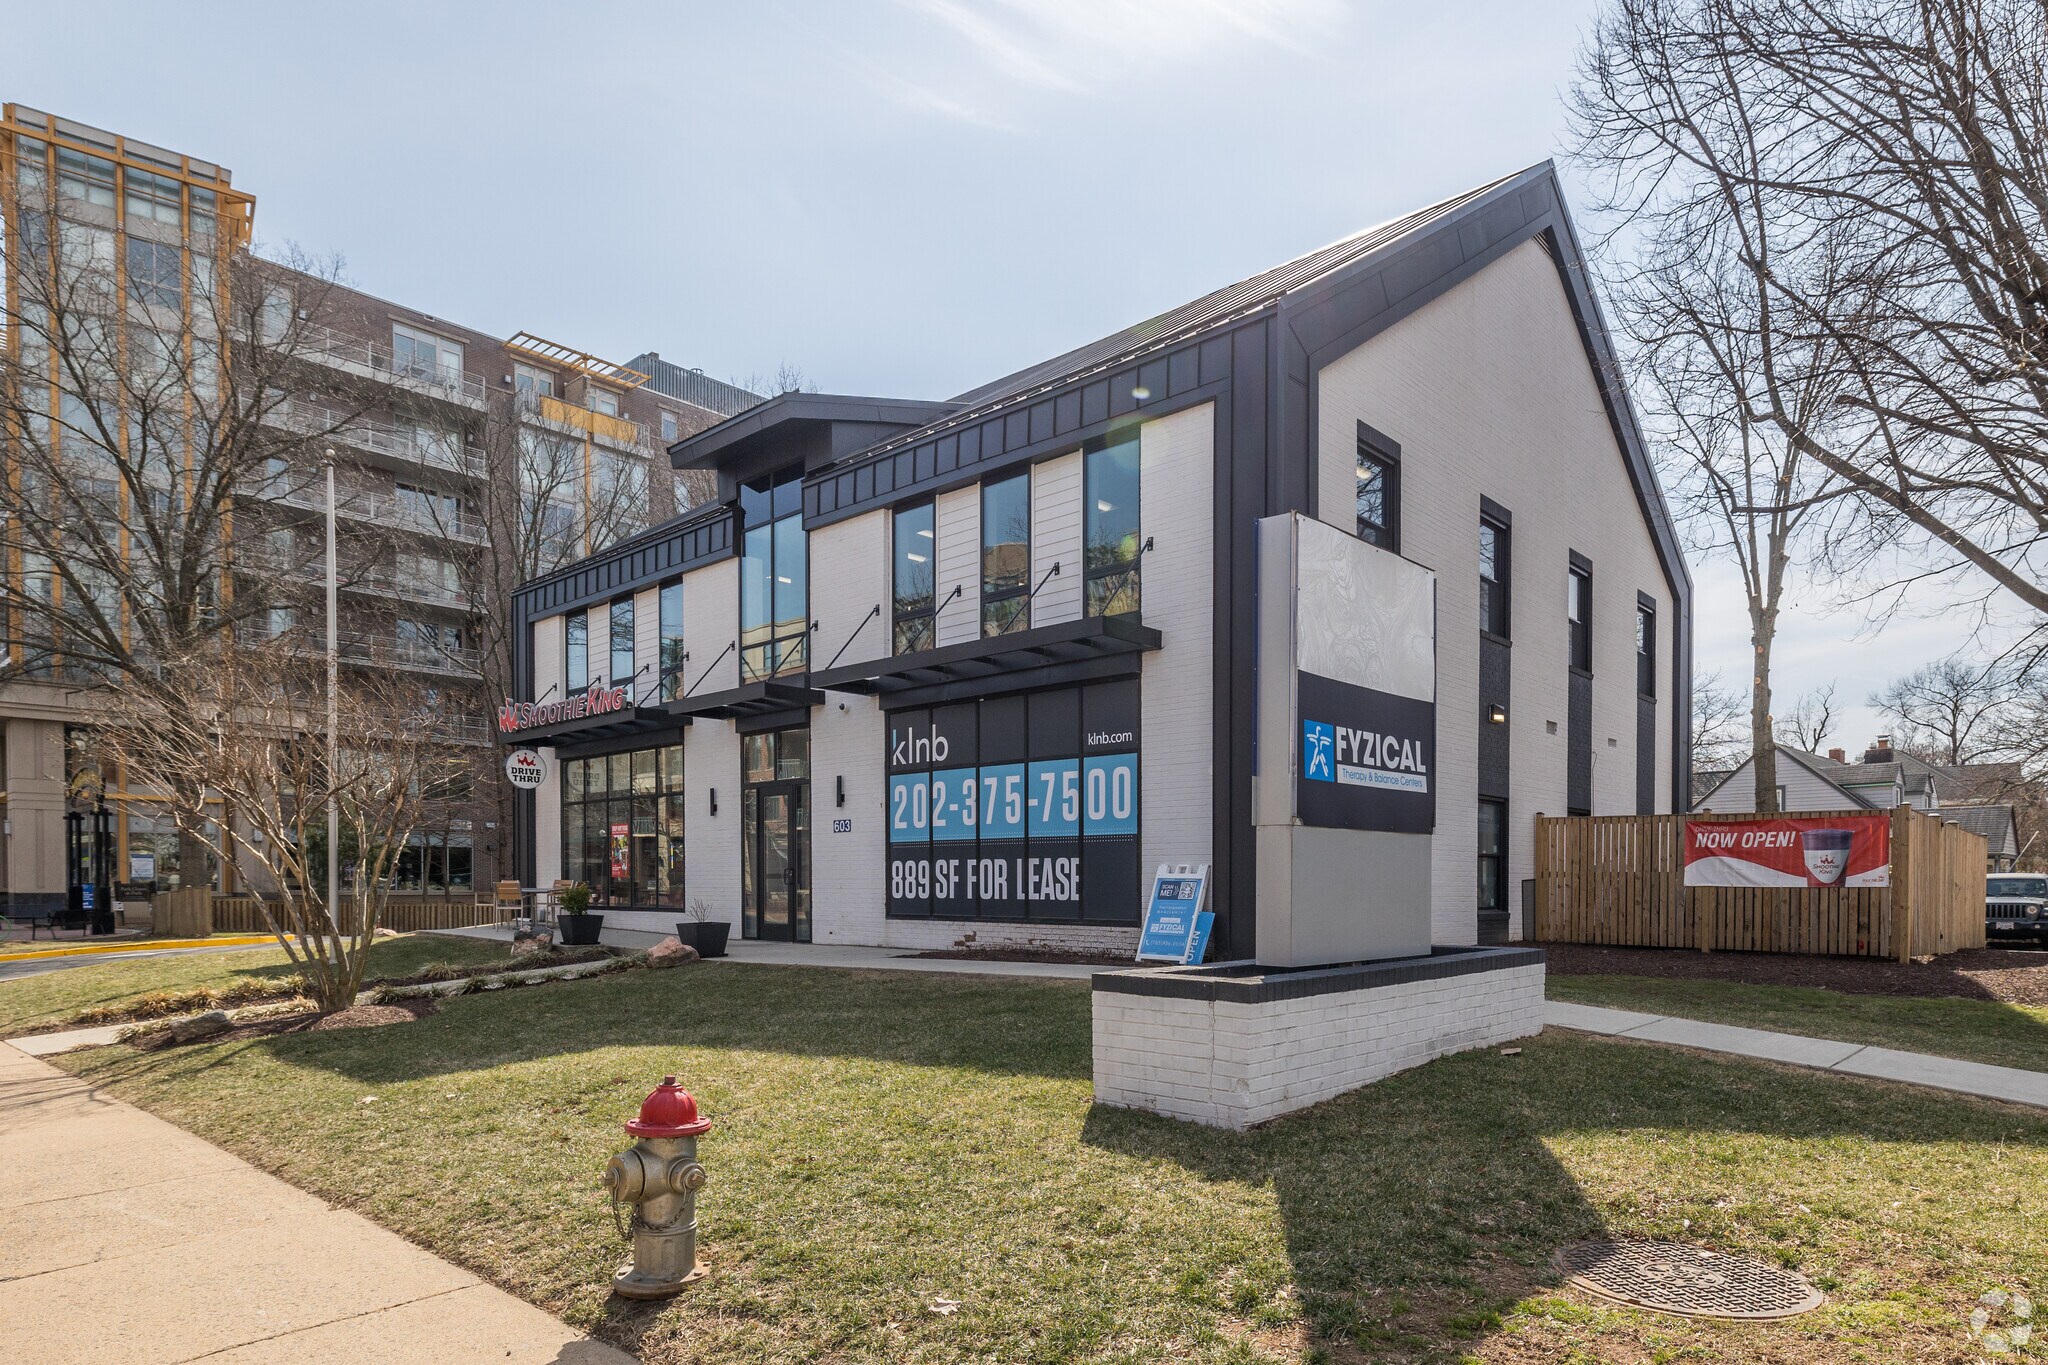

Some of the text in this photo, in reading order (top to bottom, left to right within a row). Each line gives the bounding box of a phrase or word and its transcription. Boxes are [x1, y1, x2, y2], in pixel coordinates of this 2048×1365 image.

[520, 686, 627, 729] SMOOTHIE KING
[892, 723, 949, 766] klnb
[1088, 731, 1133, 746] klnb.com
[1335, 725, 1427, 773] FYZICAL
[511, 766, 542, 777] DRIVE
[512, 774, 541, 784] THRU
[1342, 767, 1423, 788] Therapy & Balance Centers
[894, 766, 1131, 829] 202-375-7500
[834, 820, 851, 832] 603
[1695, 831, 1796, 848] NOW OPEN!
[891, 857, 1080, 900] 889 SF FOR LEASE
[1160, 923, 1185, 931] FYZICAL
[1187, 929, 1200, 962] OPEN
